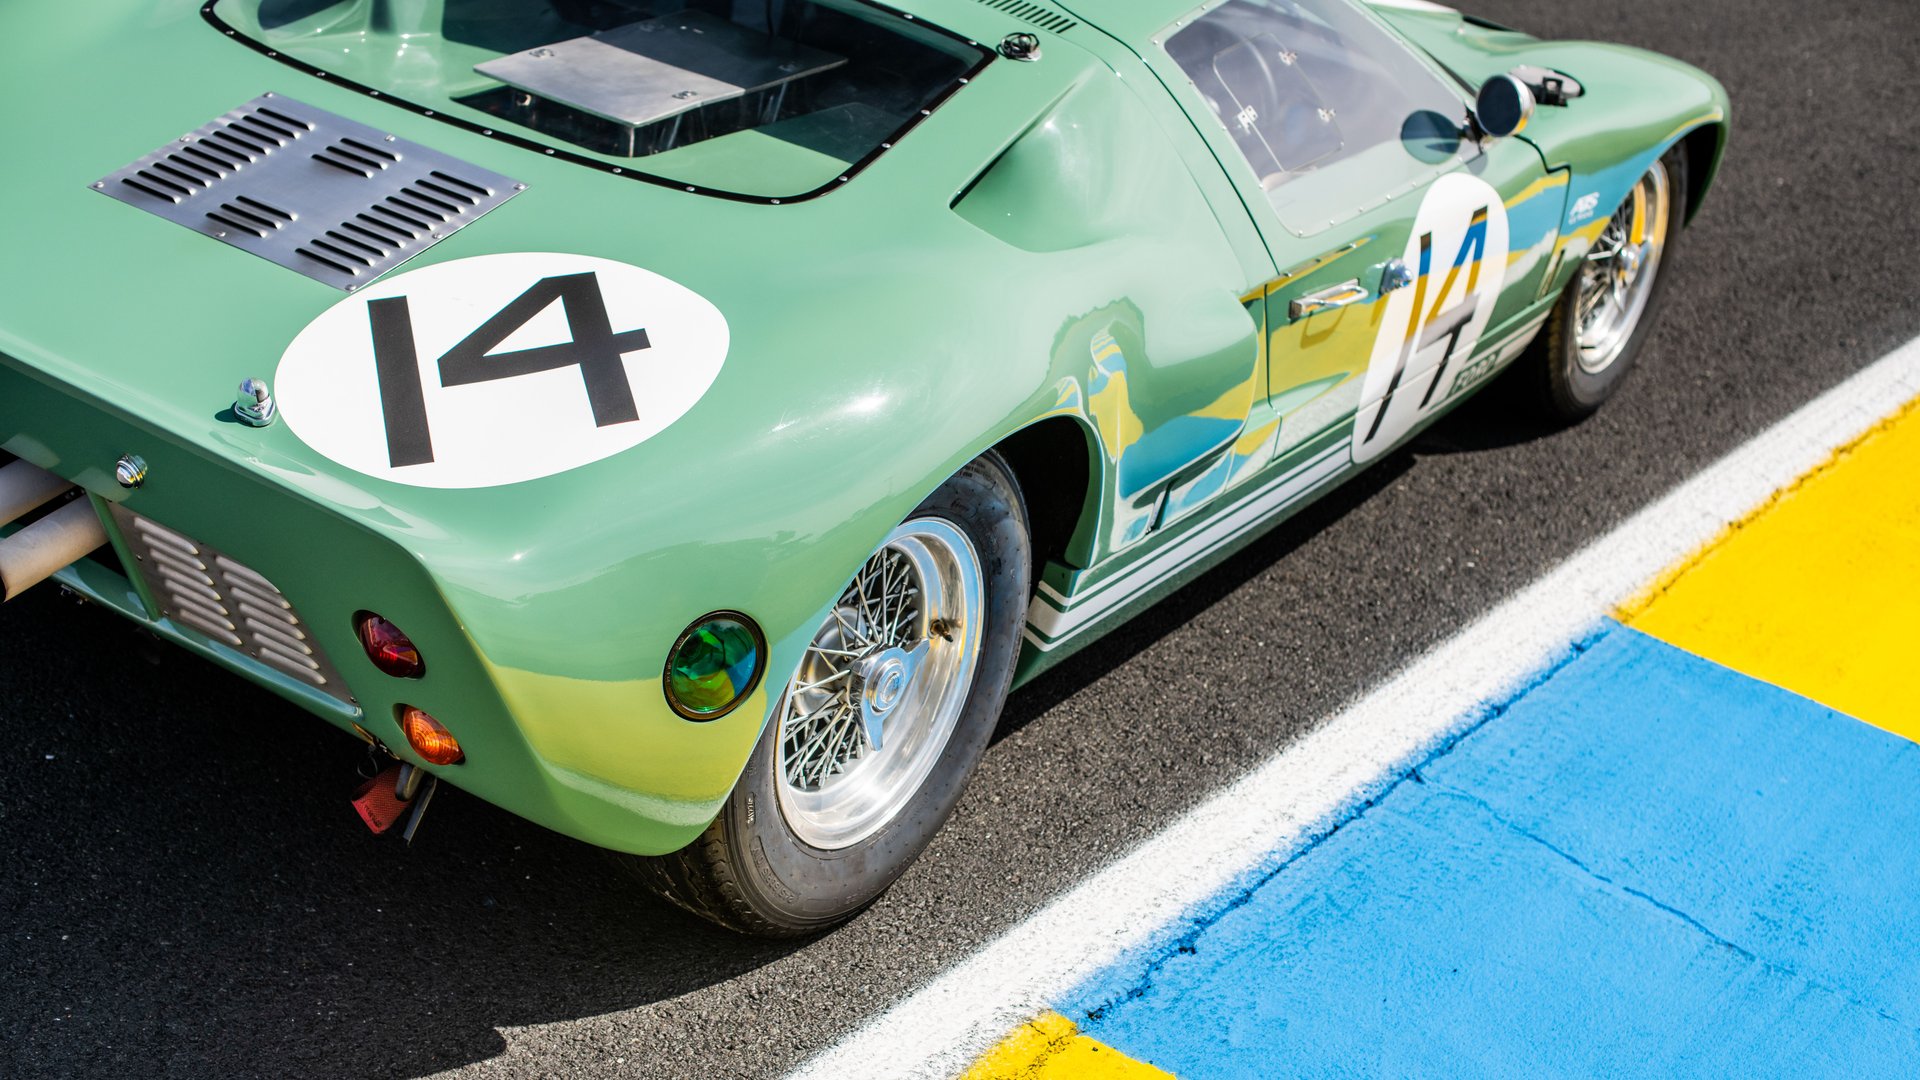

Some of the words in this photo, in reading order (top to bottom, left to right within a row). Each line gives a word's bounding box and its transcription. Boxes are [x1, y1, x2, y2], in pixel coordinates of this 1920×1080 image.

[367, 271, 652, 469] 14
[1363, 205, 1488, 444] 14
[1452, 353, 1496, 394] FORD
